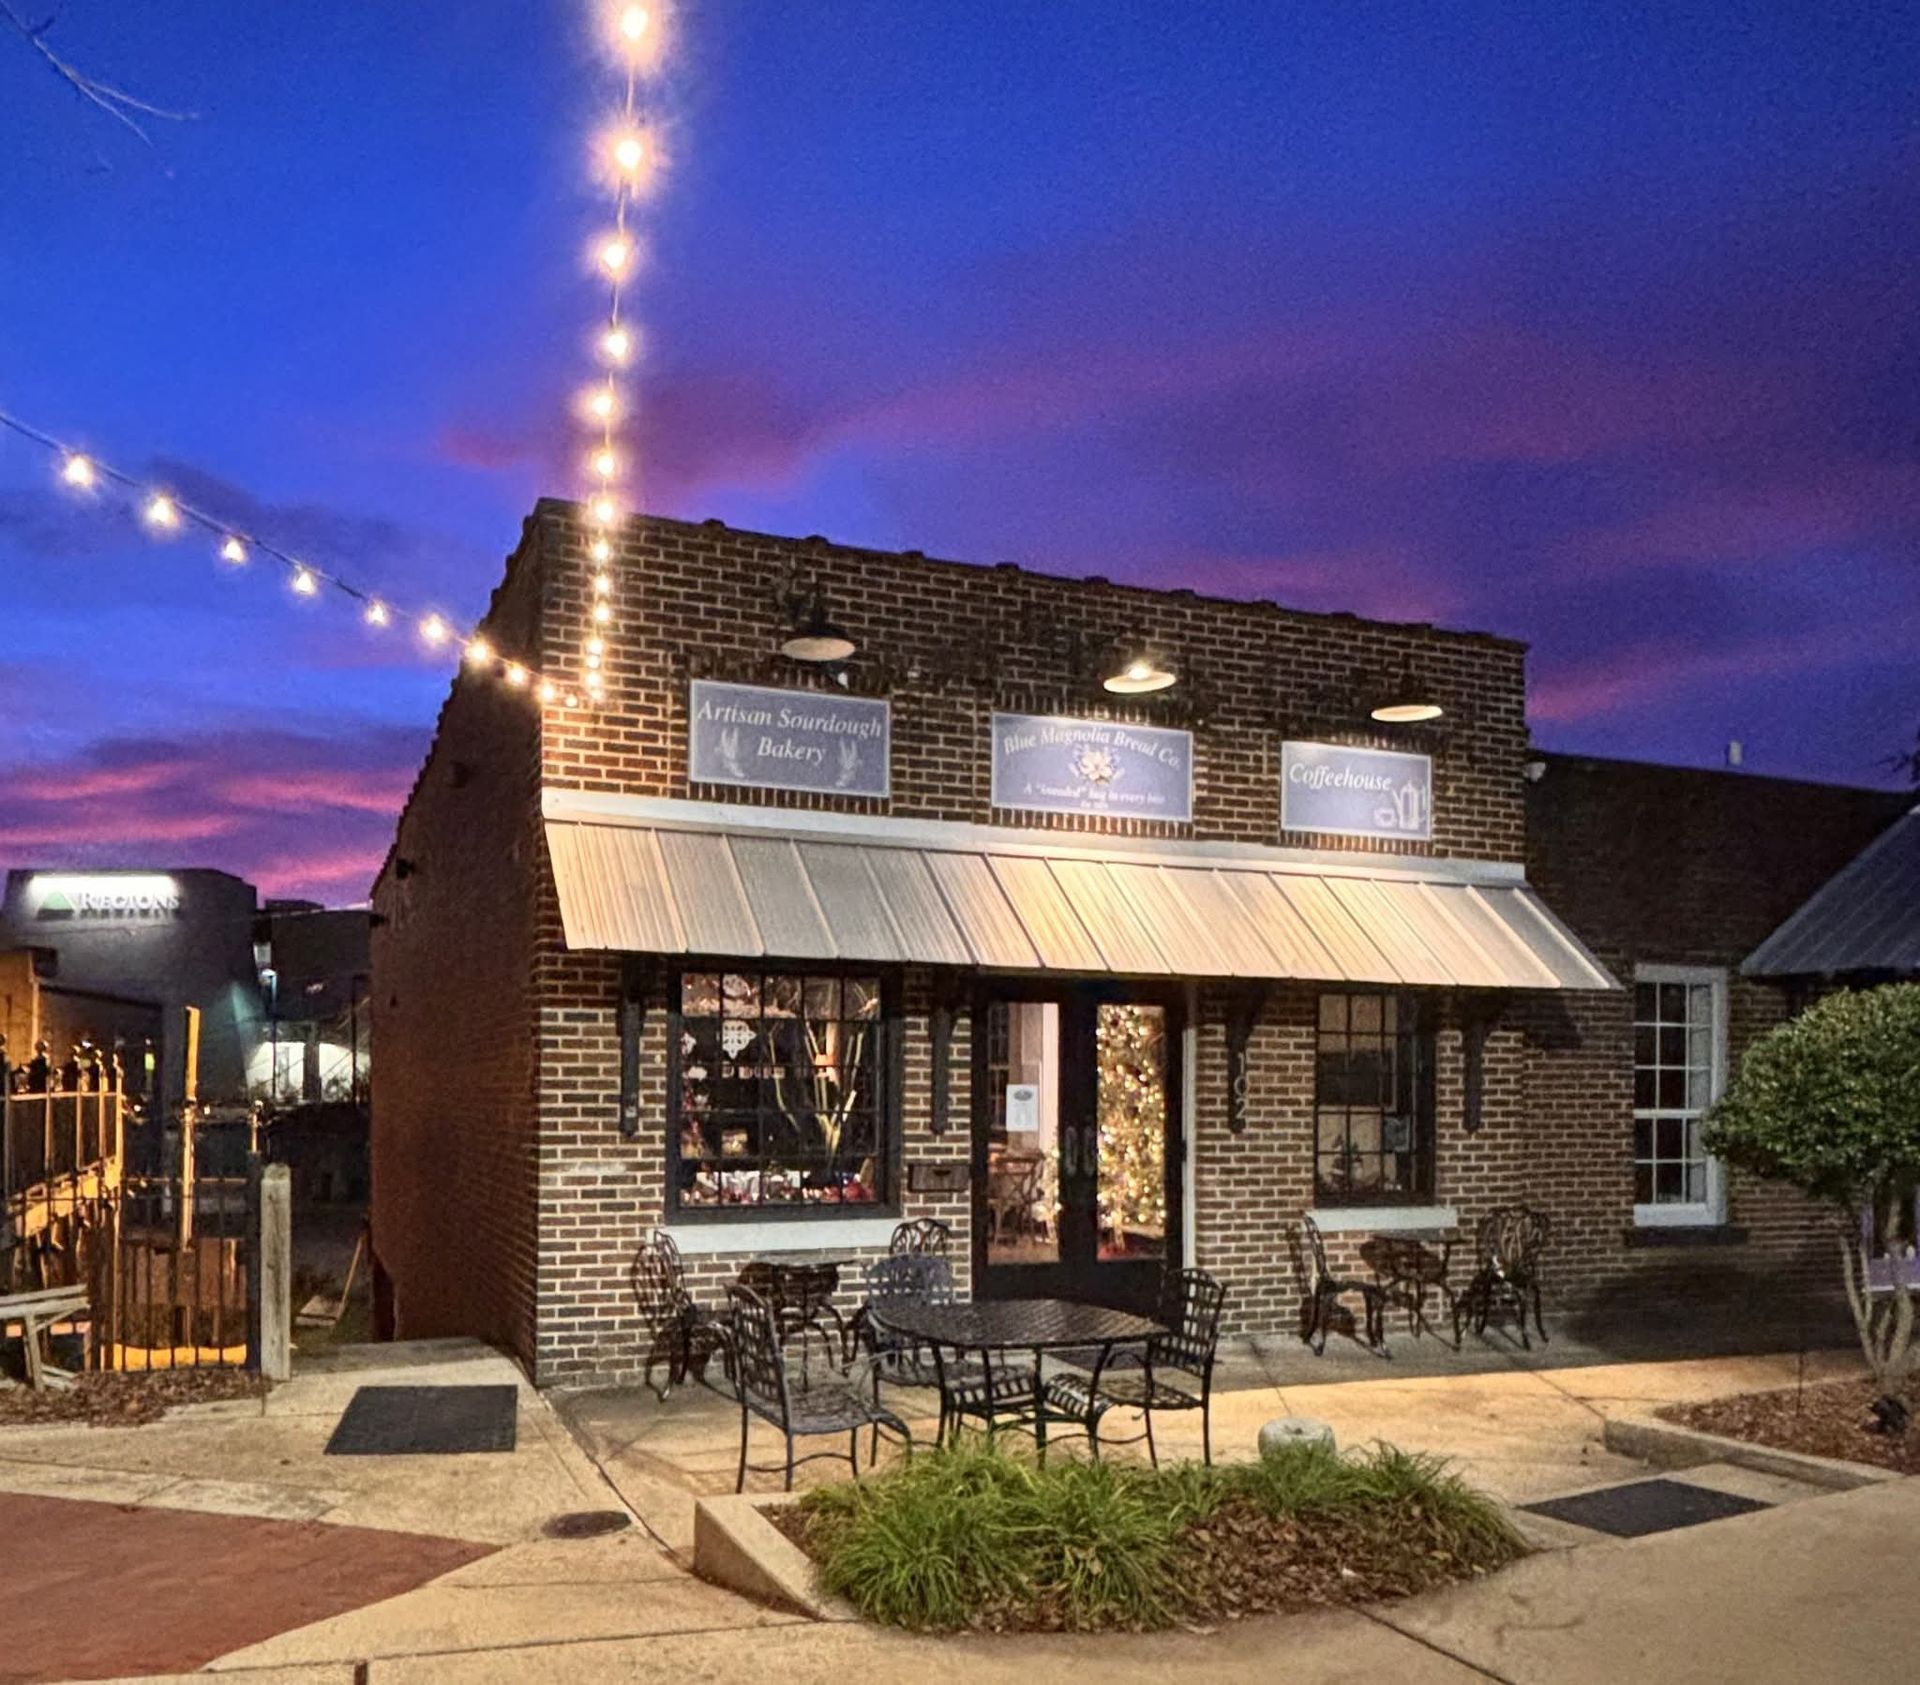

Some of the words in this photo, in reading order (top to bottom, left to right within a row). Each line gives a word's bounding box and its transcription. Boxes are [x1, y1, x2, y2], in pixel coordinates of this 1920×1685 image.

[697, 700, 772, 726] Artisan
[777, 708, 882, 739] Sourdough
[757, 736, 827, 766] Bakery
[1003, 734, 1037, 756] Blue
[1040, 726, 1111, 745] Magnolia
[1114, 731, 1158, 757] Bread
[1289, 762, 1393, 791] Coffeehouse
[79, 892, 181, 913] REGIONS
